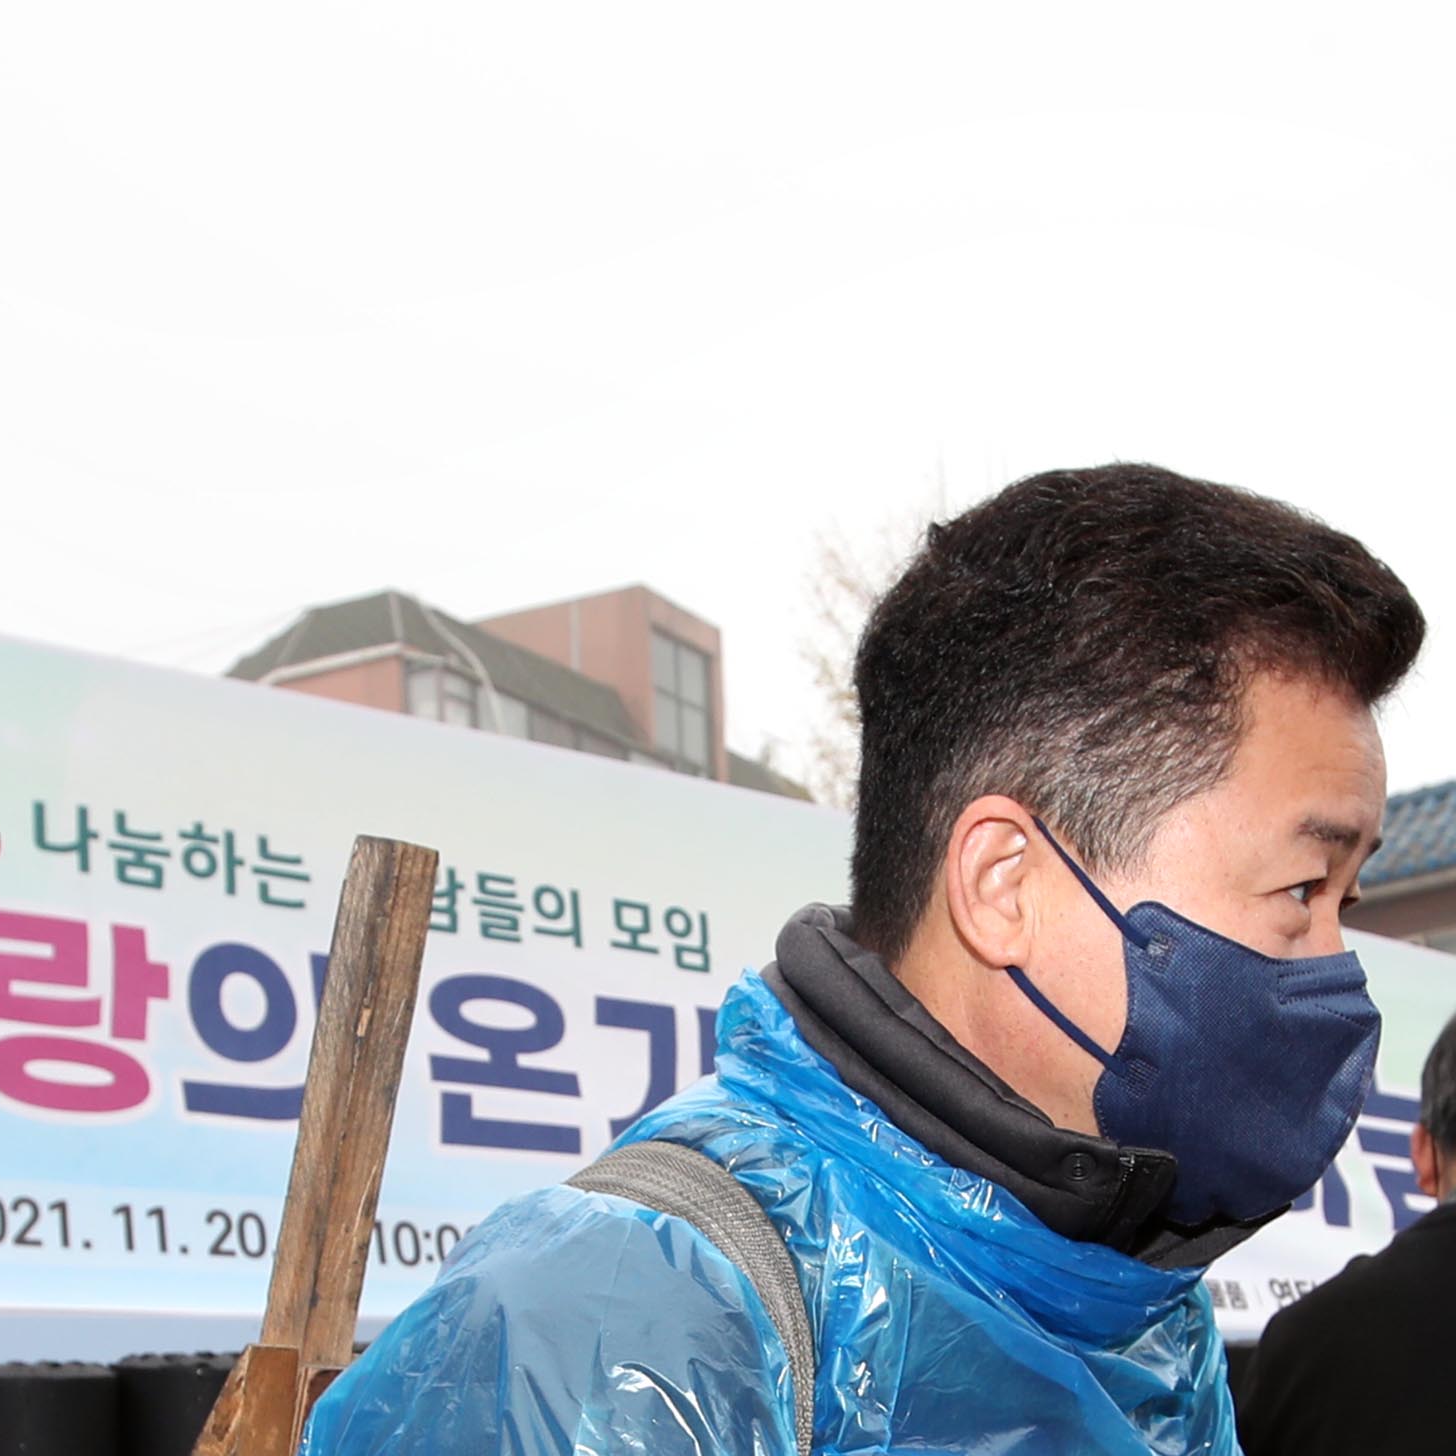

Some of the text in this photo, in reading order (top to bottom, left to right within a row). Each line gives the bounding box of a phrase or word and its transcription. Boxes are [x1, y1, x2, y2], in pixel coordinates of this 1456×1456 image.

[33, 799, 312, 909] 나눔하는
[609, 897, 713, 974] 모임
[112, 1203, 191, 1256] 11.
[204, 1208, 276, 1260] 20
[373, 1219, 478, 1267] 10:0
